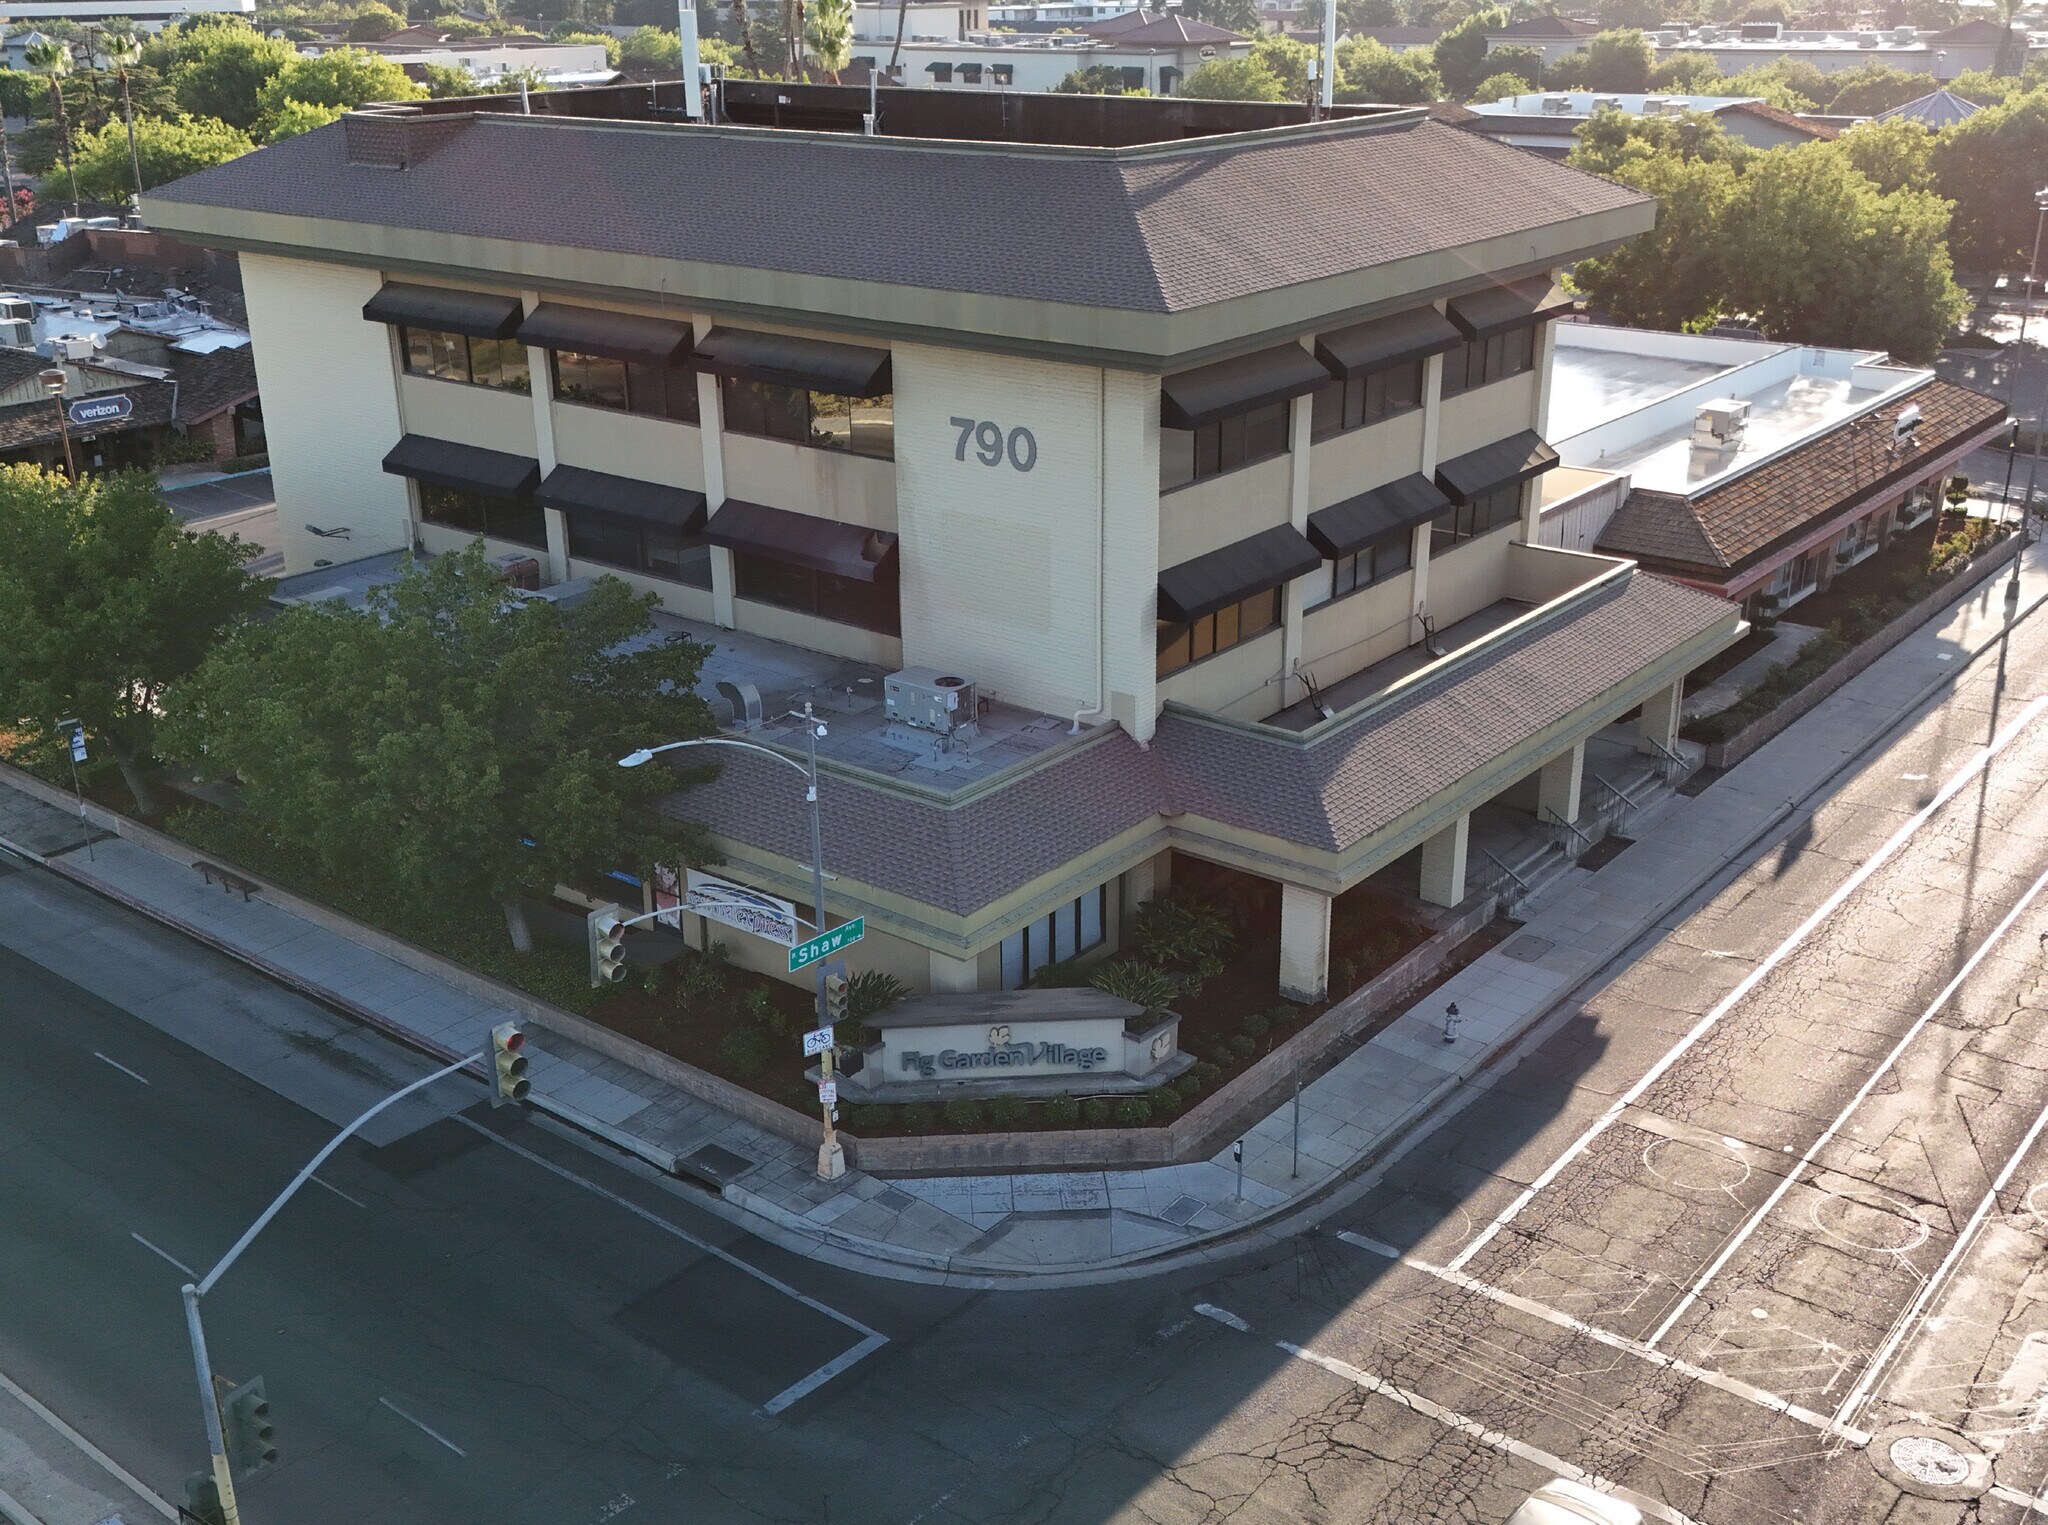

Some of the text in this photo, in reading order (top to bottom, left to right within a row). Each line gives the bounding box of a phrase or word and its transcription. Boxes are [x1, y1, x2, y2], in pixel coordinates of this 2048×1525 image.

[80, 404, 120, 419] verizon
[950, 416, 1038, 473] 790
[798, 933, 843, 963] Shaw
[901, 1041, 1108, 1078] Fig Garden Village
